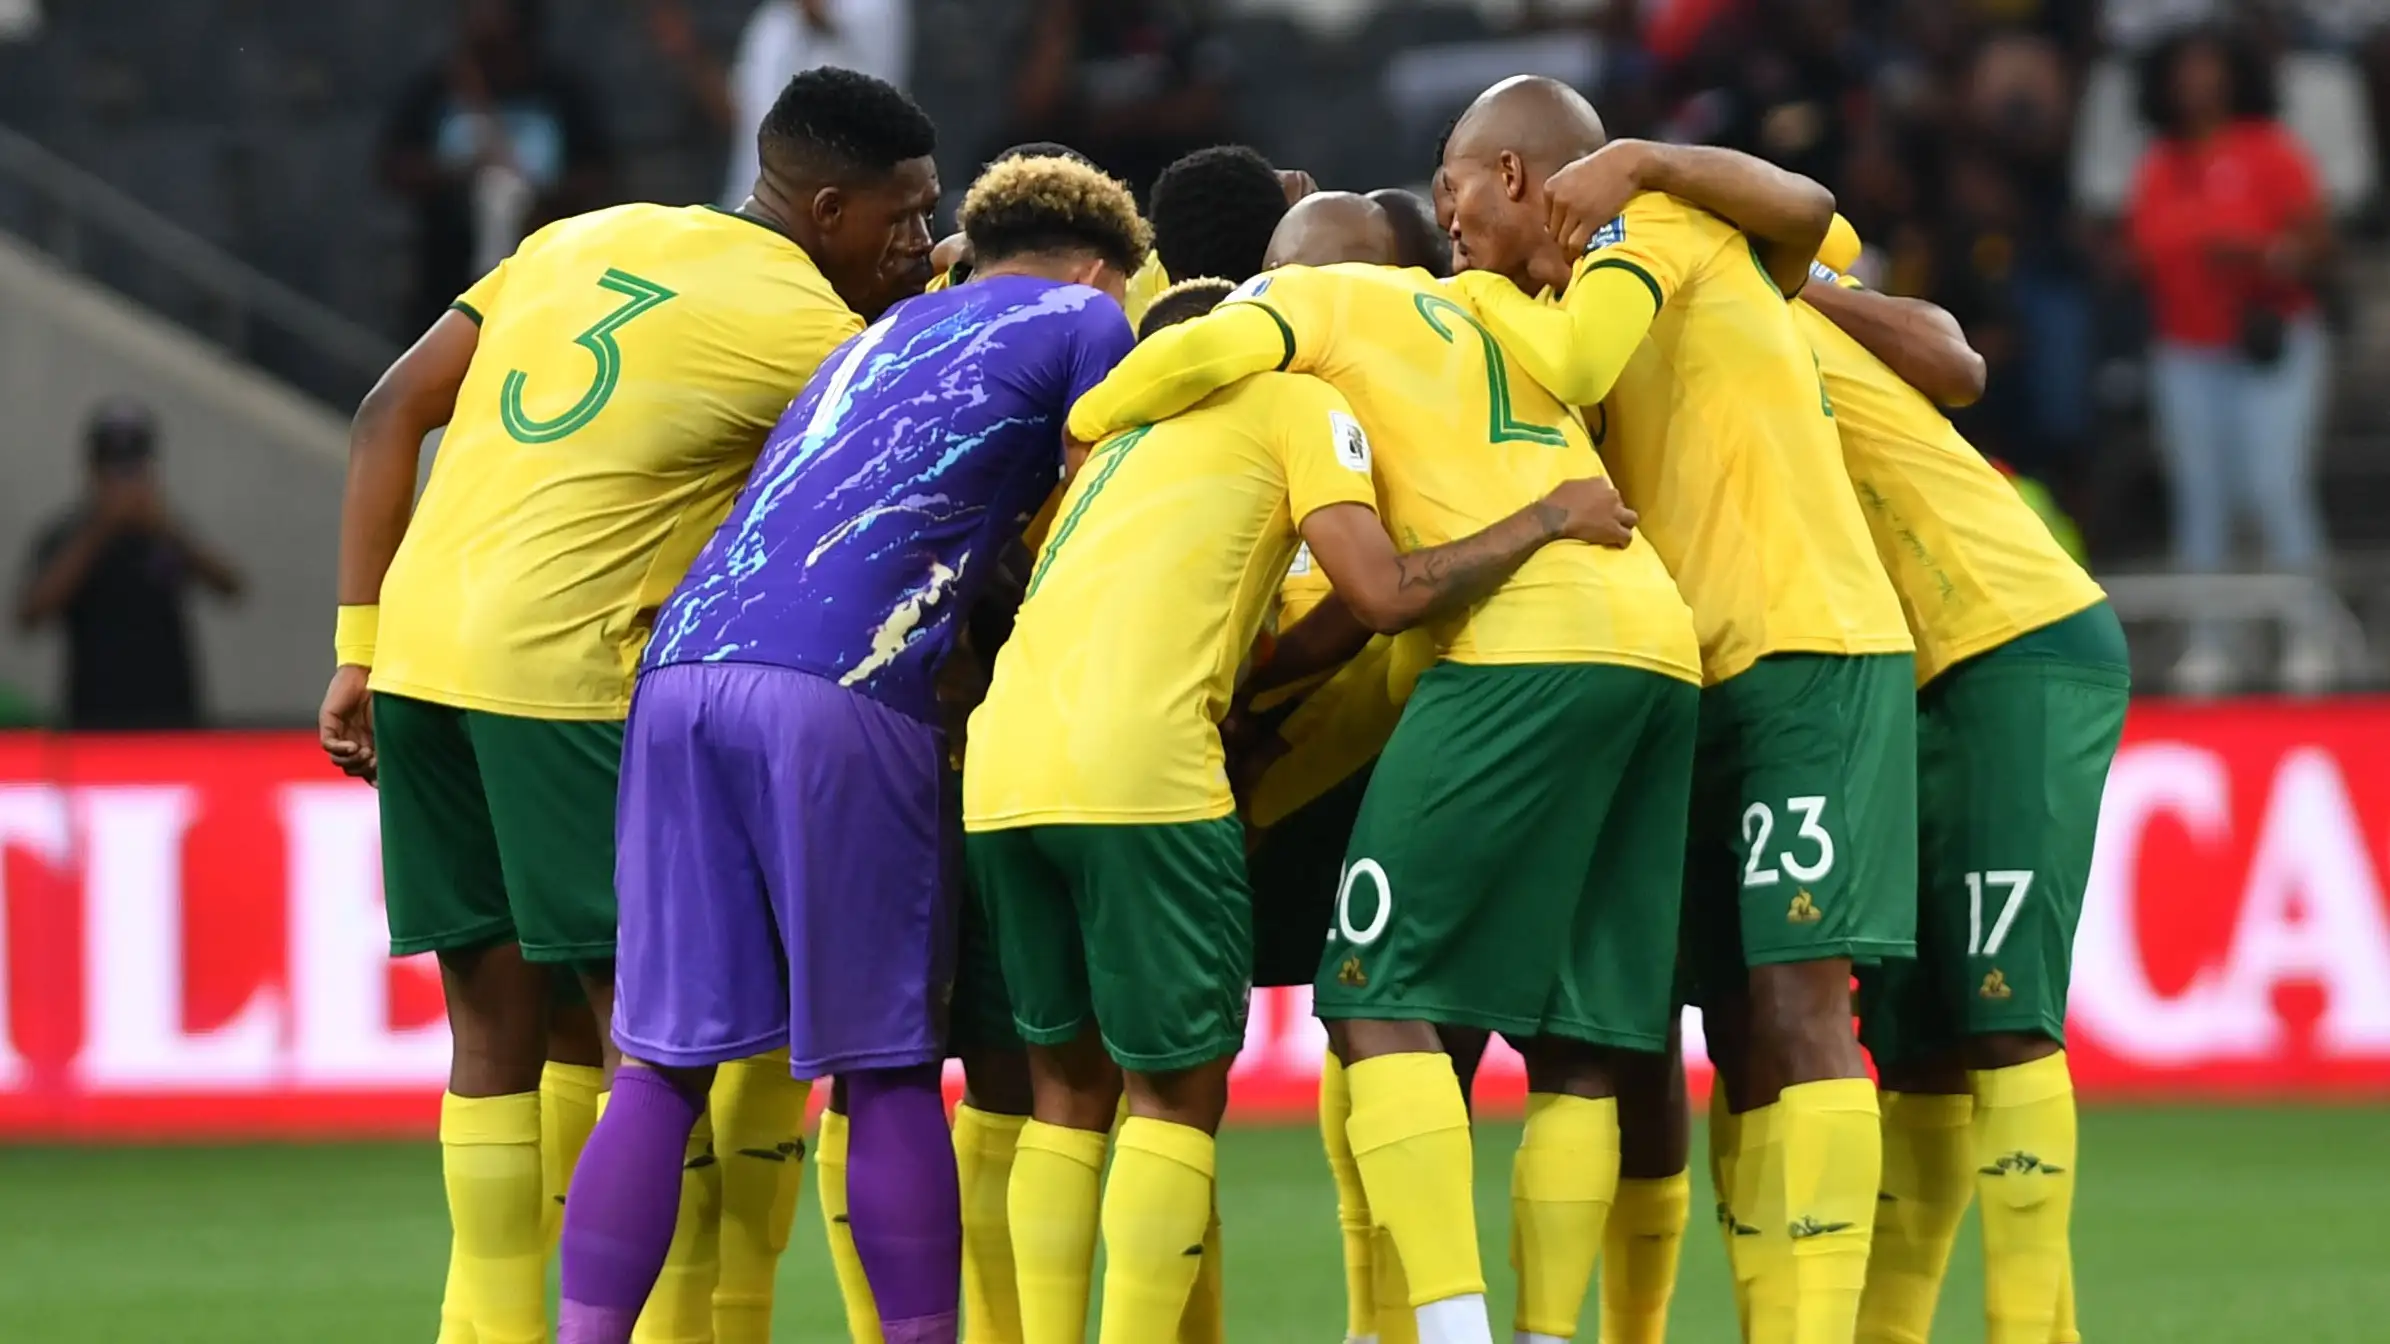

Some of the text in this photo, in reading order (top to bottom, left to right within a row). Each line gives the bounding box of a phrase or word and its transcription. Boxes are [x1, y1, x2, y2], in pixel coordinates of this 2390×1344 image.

[501, 267, 679, 444] 3
[805, 313, 898, 437] 1
[1025, 424, 1153, 603] 7
[1742, 795, 1834, 887] 23
[1326, 857, 1392, 945] 0
[1964, 870, 2034, 956] 17
